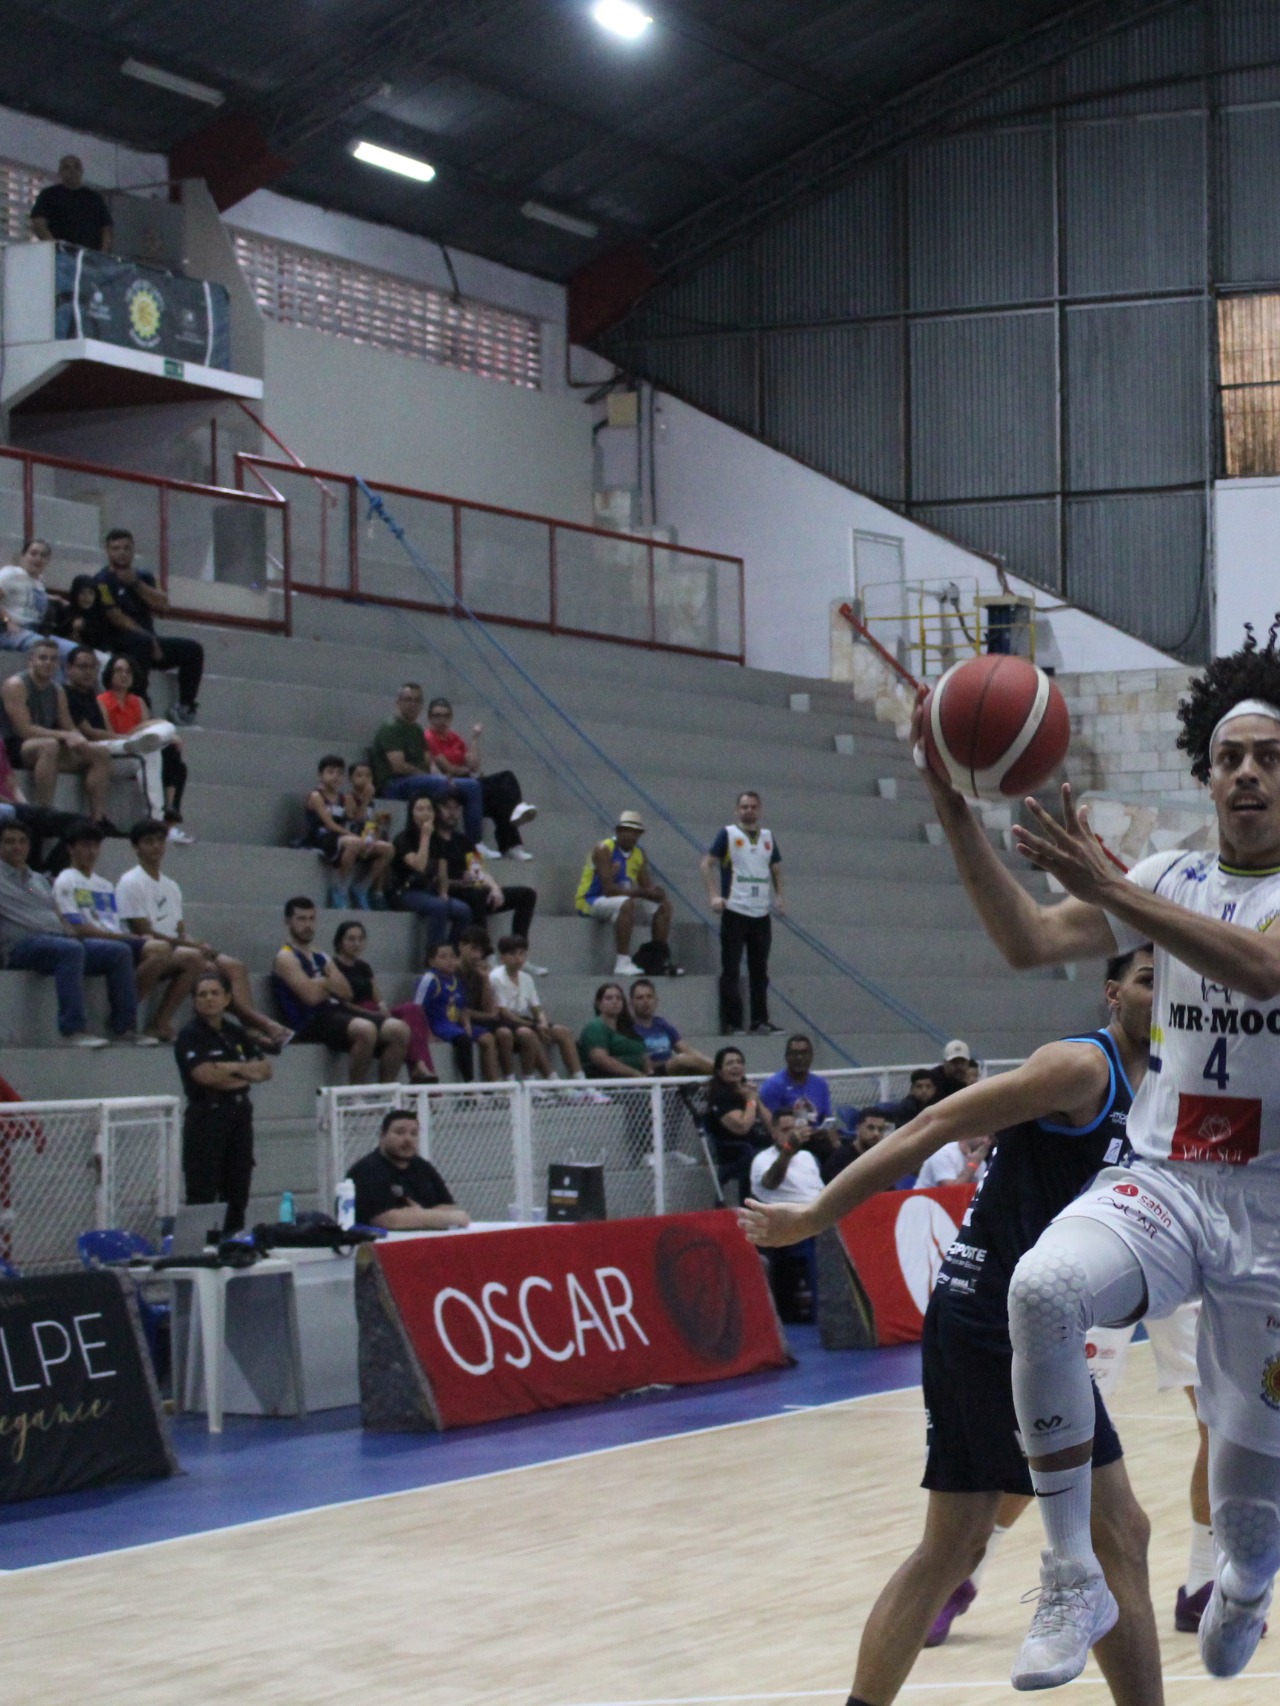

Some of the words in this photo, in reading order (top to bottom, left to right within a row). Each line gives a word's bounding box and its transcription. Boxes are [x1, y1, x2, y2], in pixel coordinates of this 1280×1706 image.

[1202, 1036, 1229, 1090] 4
[1141, 1195, 1172, 1228] sabin
[433, 1266, 650, 1376] OSCAR
